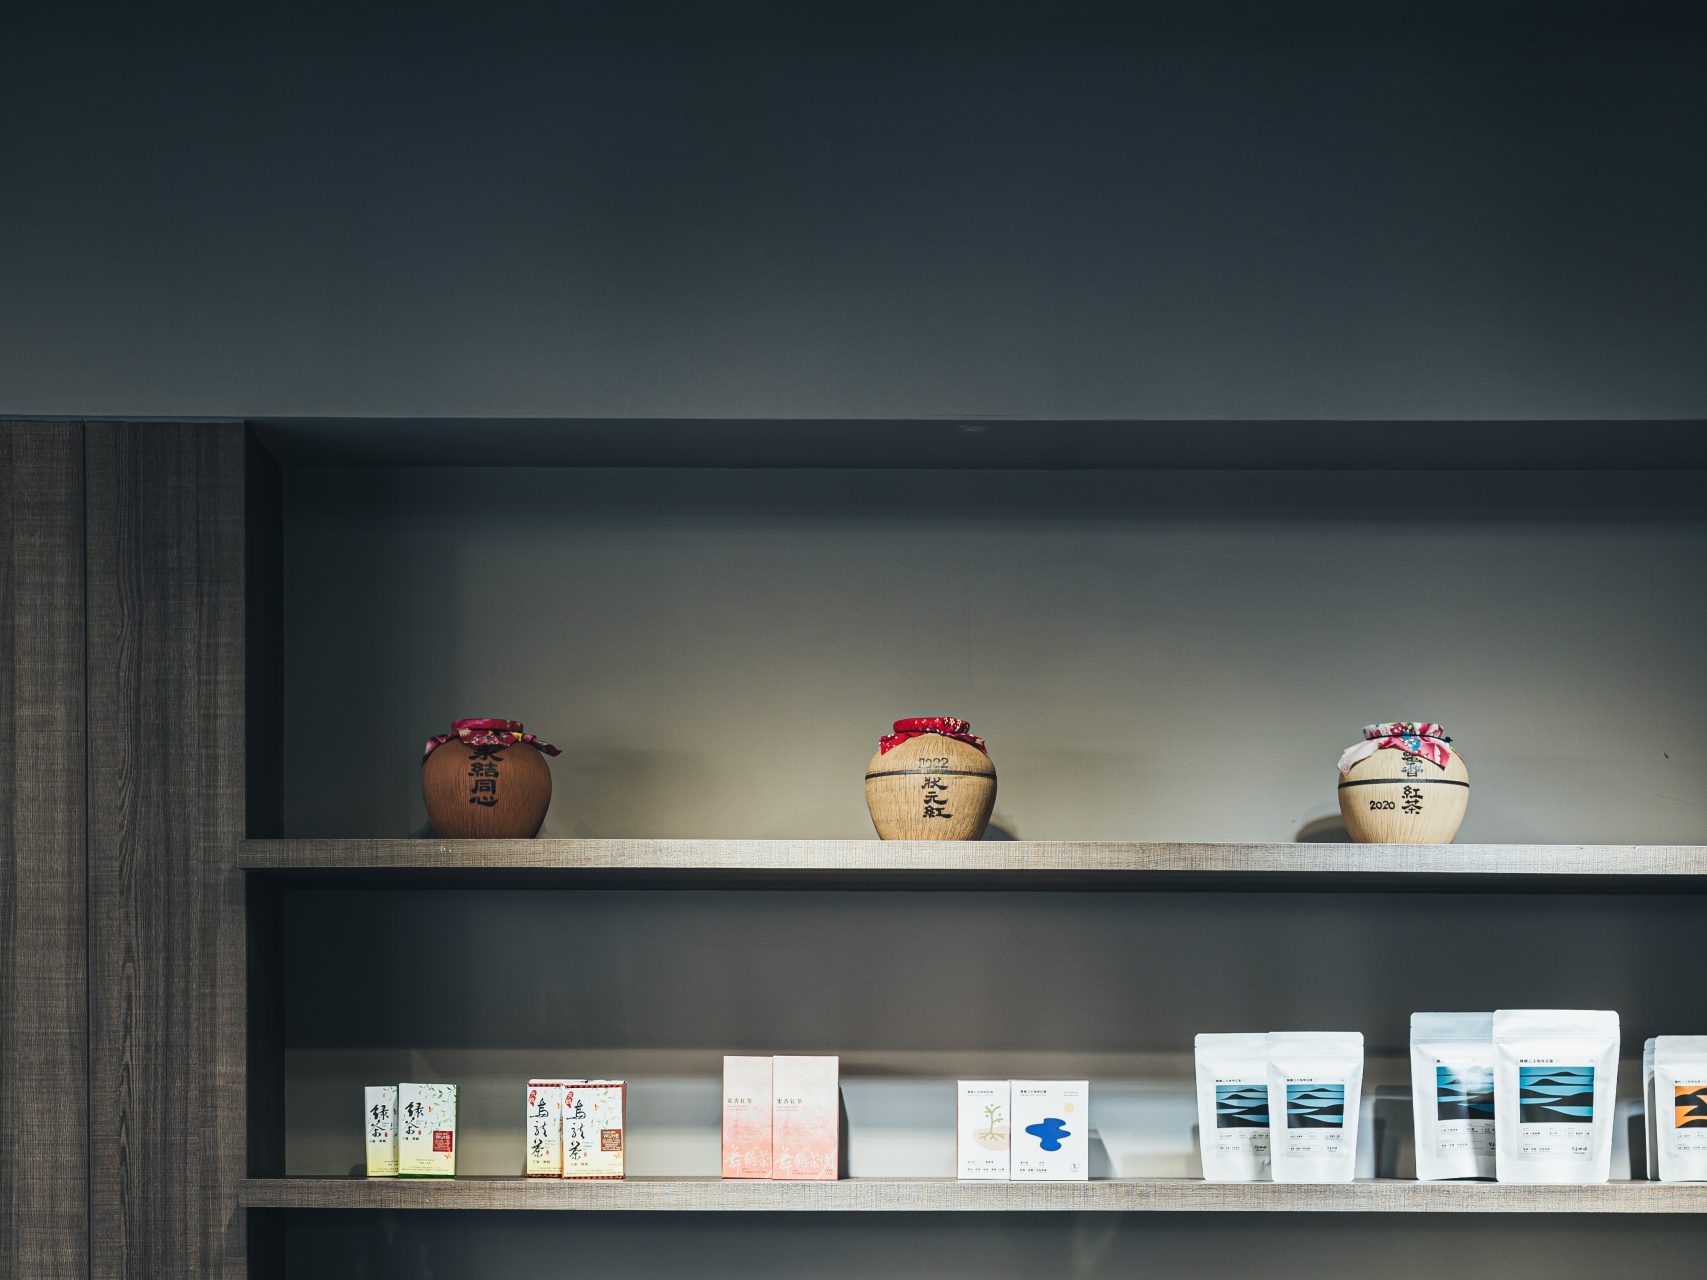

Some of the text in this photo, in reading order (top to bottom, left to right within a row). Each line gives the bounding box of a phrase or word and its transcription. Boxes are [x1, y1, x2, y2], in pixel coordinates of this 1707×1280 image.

[921, 776, 953, 819] 狀元紅
[1369, 800, 1396, 811] 2020
